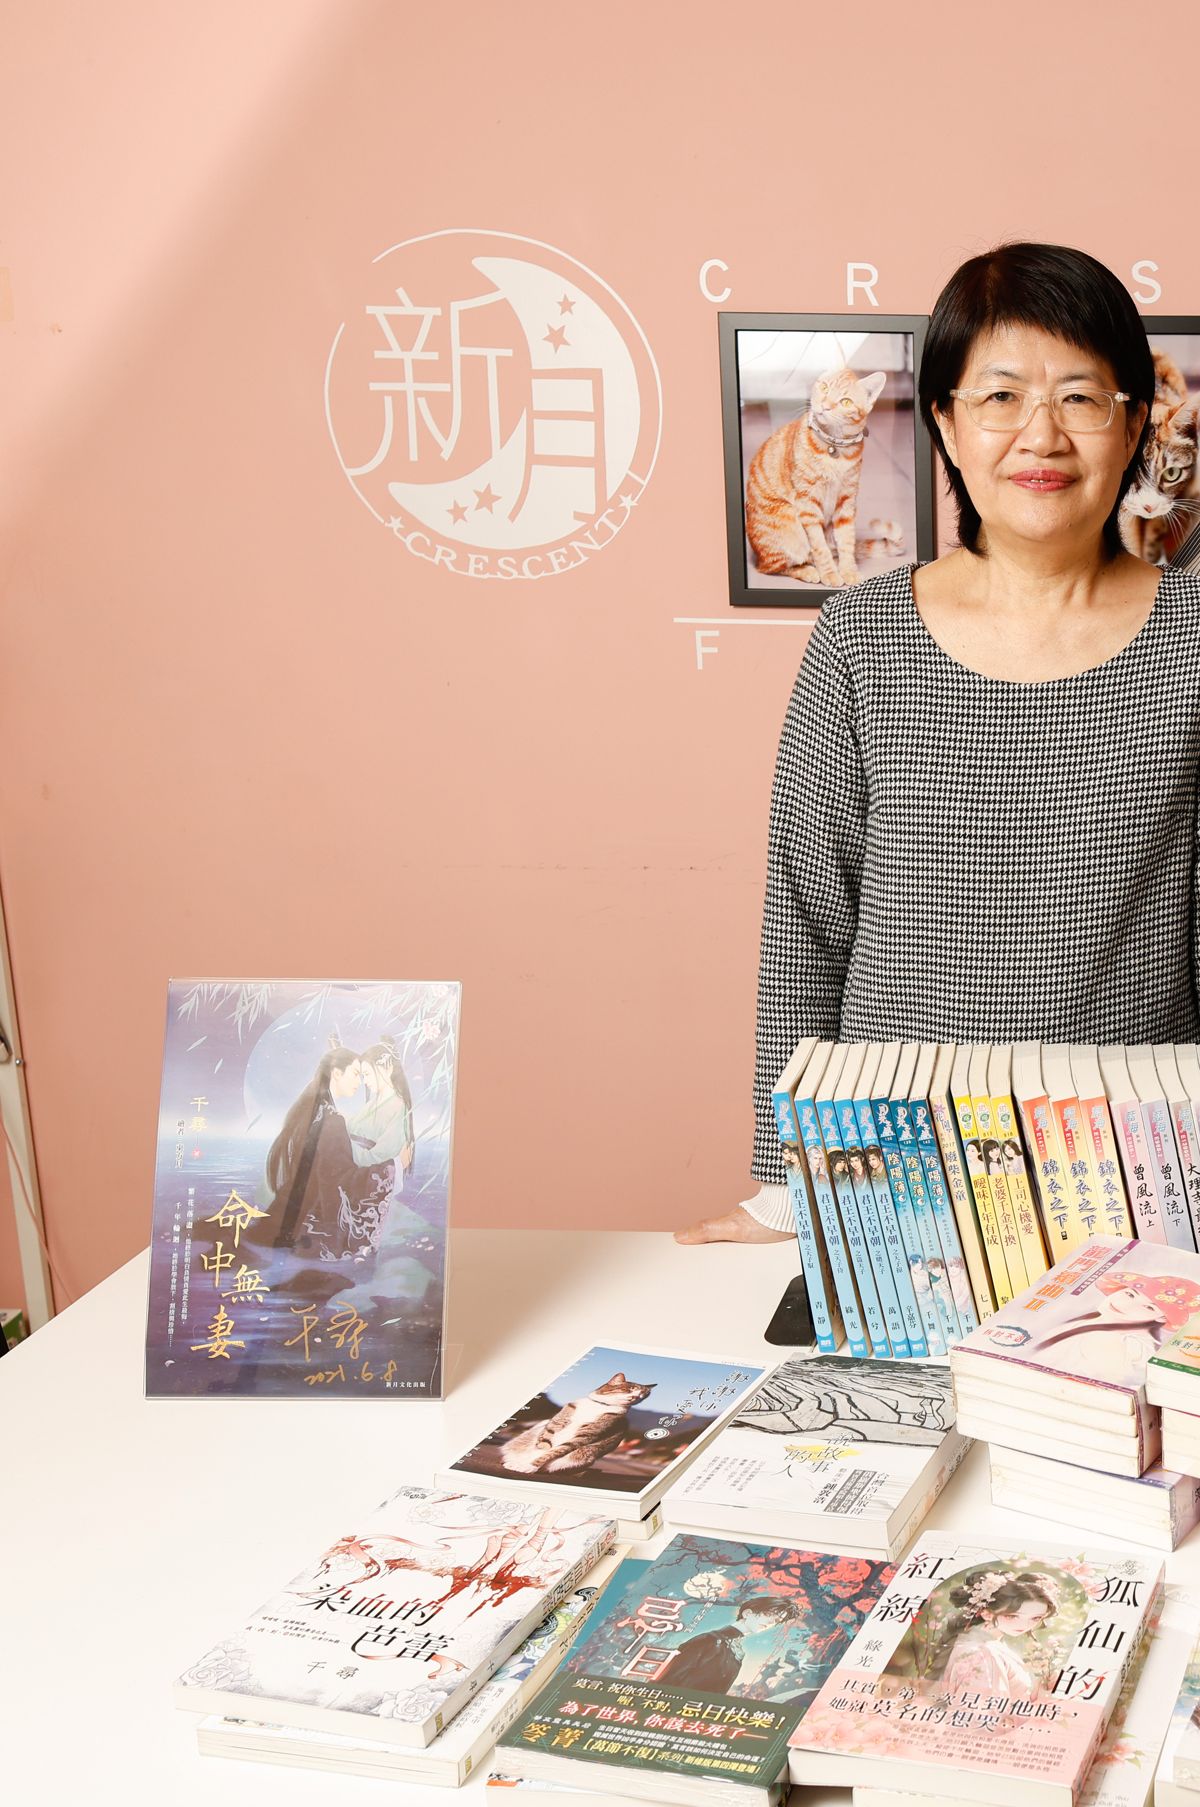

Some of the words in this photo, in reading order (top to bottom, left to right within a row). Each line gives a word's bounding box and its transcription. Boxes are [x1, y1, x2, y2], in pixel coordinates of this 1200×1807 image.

[344, 286, 606, 523] 新月
[404, 508, 634, 578] CRESCENT
[793, 1188, 812, 1241] 君王不早朝
[994, 1178, 1017, 1246] 老婆千金不換
[1015, 1178, 1034, 1236] 上司心機愛
[1042, 1158, 1069, 1230] 錦衣之下
[1070, 1160, 1097, 1230] 錦衣之下
[1097, 1159, 1125, 1230] 錦衣之下
[1134, 1163, 1157, 1216] 曾風流
[1146, 1219, 1155, 1228] 上
[1161, 1163, 1184, 1216] 曾風流
[821, 1193, 840, 1246] 君王不早朝
[842, 1193, 862, 1247] 君王不早朝
[862, 1193, 881, 1247] 君王不早朝
[880, 1193, 899, 1245] 君王不早朝
[1172, 1218, 1181, 1227] 下
[190, 1188, 271, 1360] 命中無妻
[296, 1583, 444, 1627] 染血的
[873, 1551, 954, 1623] 紅線
[350, 1624, 455, 1662] 芭蕾
[617, 1596, 688, 1681] 忌日
[855, 1639, 884, 1668] 綠光
[1051, 1575, 1145, 1702] 狐仙的
[522, 1722, 584, 1749] 笭菁
